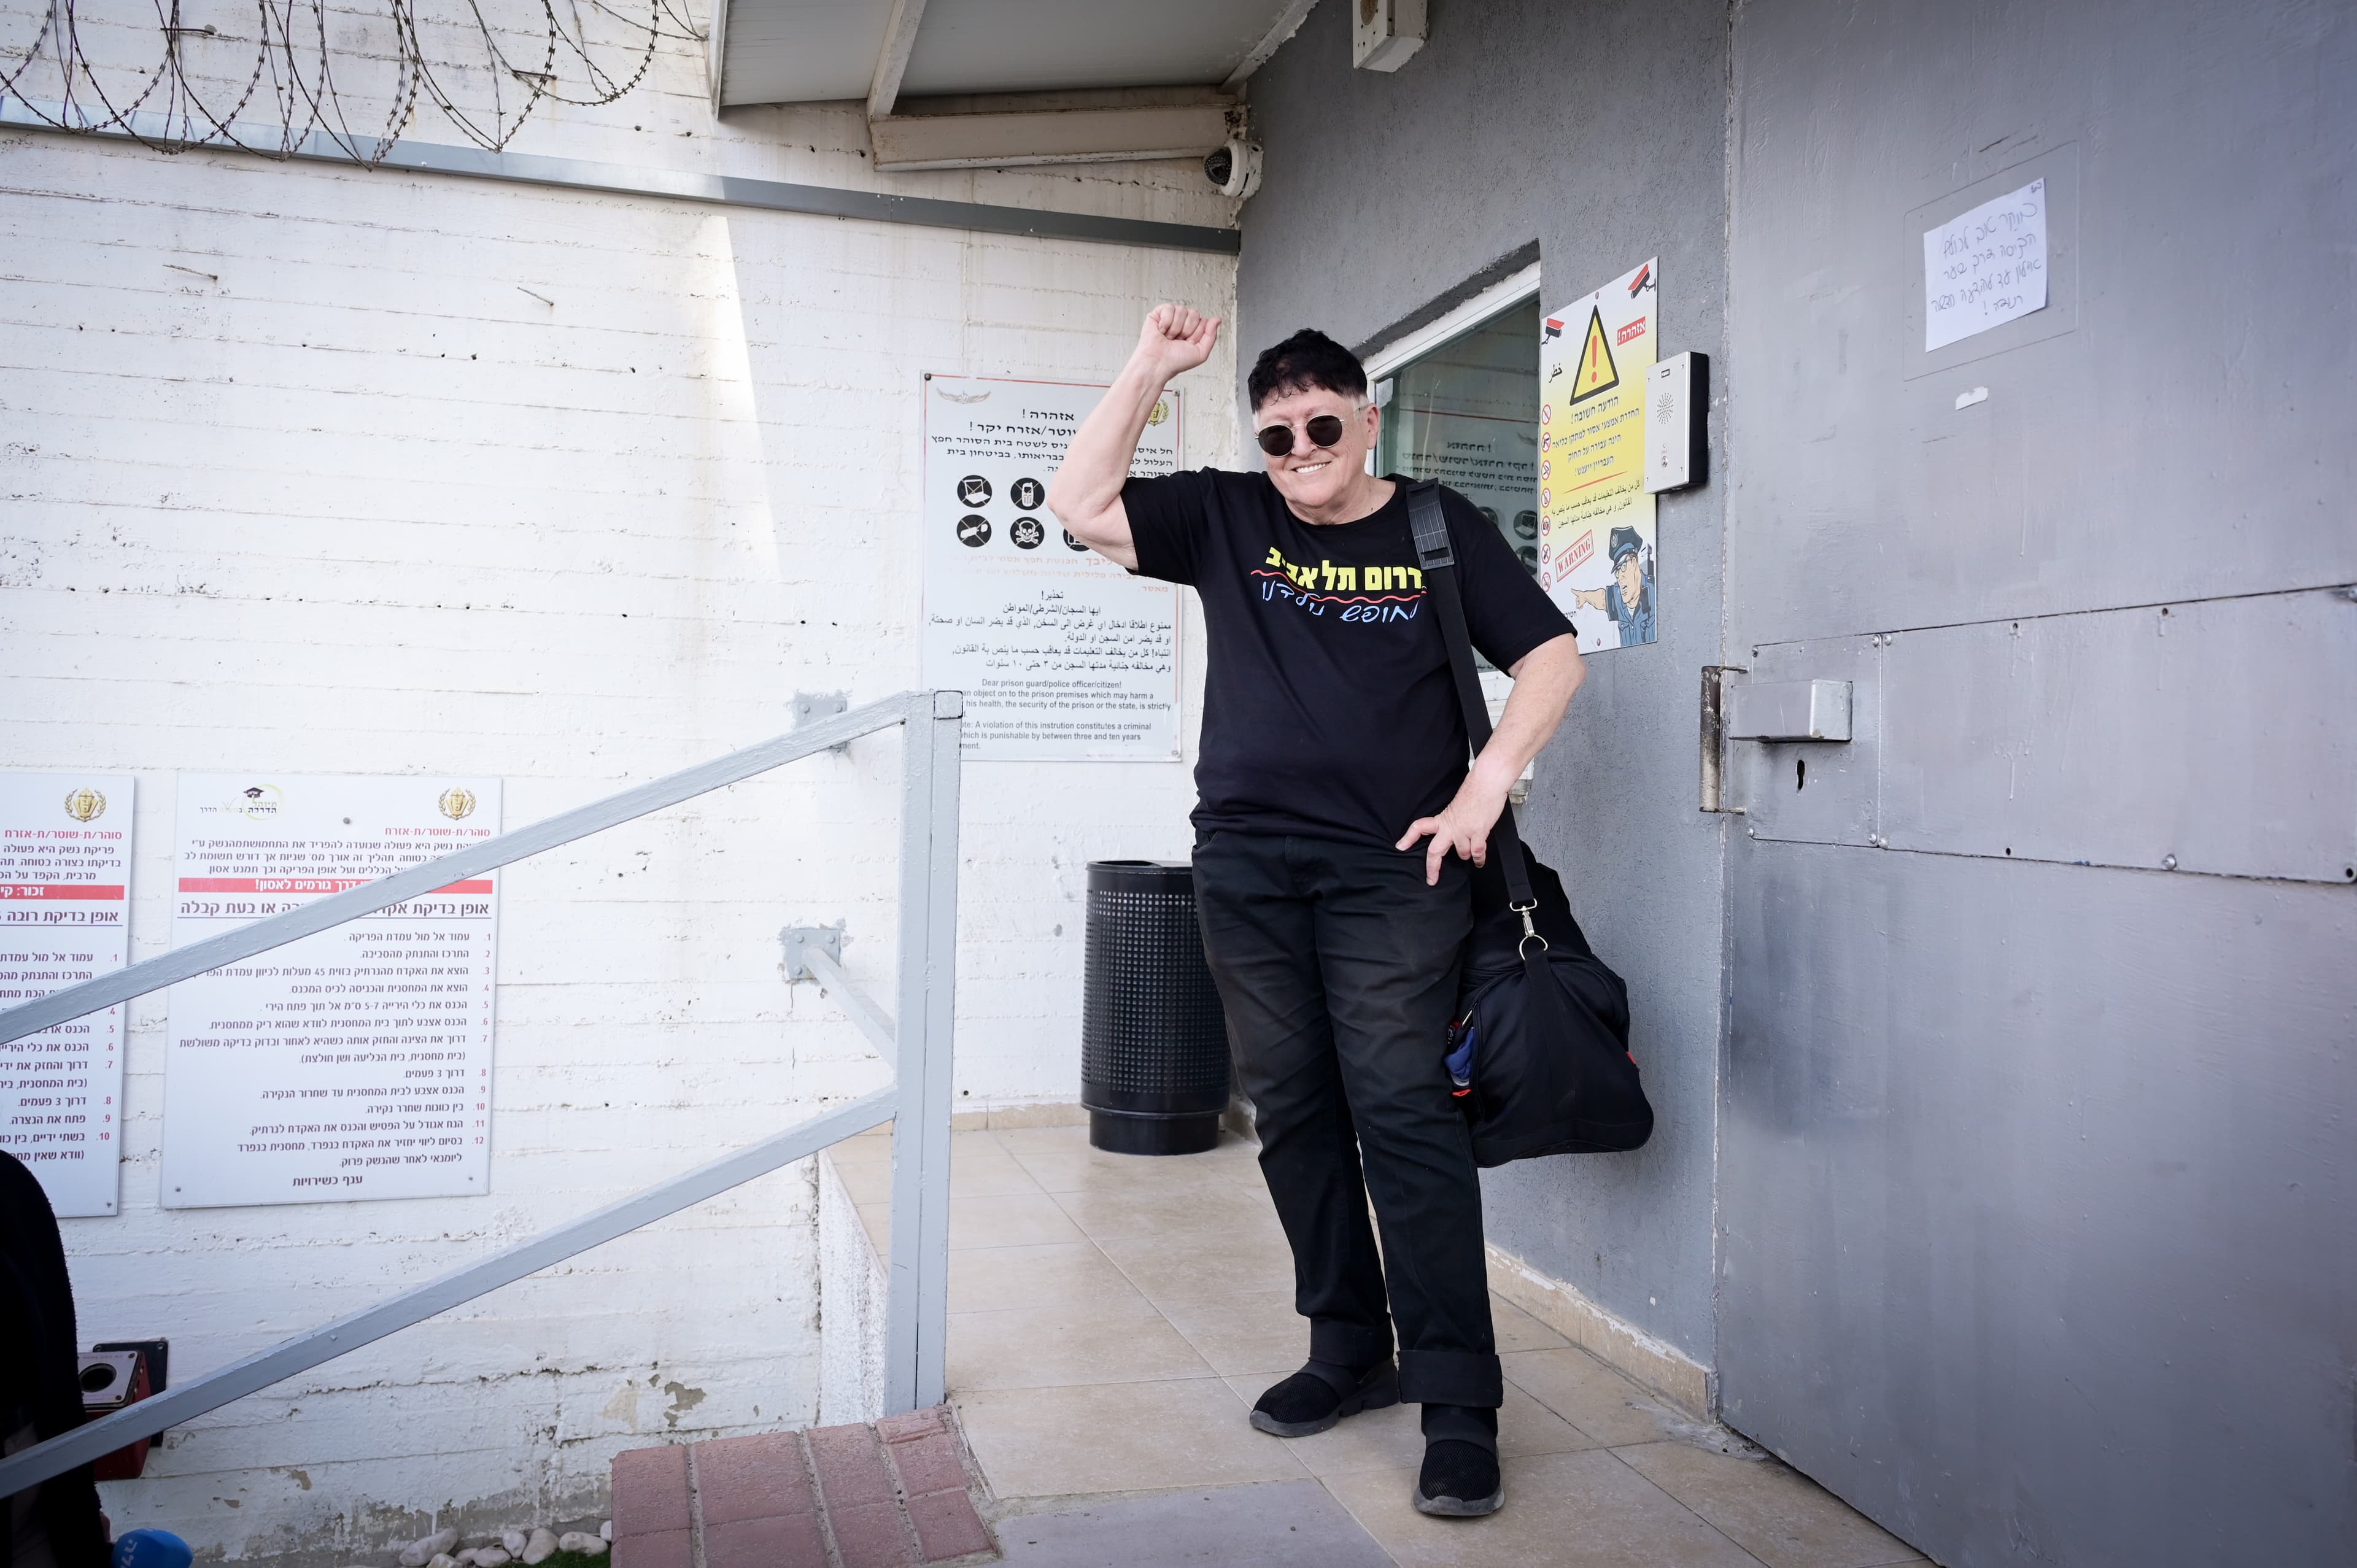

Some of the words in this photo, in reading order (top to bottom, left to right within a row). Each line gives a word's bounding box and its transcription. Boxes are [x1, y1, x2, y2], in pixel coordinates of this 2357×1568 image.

[1618, 321, 1646, 344] אזהרה!
[1549, 363, 1563, 383] خطر
[1598, 396, 1619, 412] הודעה
[1029, 411, 1074, 420] אזהרה
[1571, 406, 1596, 424] חשובה!
[1620, 407, 1639, 423] החדרת
[977, 423, 1001, 433] יקר
[1587, 423, 1600, 434] אסור
[1569, 428, 1585, 445] למתקן
[1608, 434, 1621, 446] הינה
[1552, 436, 1568, 449] כליאה
[1590, 439, 1607, 452] עבירה
[1583, 446, 1589, 455] על
[1568, 449, 1582, 463] החוק
[1593, 455, 1614, 471] העבריין
[1558, 538, 1590, 573] WARNING
[1266, 547, 1318, 589] אביב
[1322, 560, 1356, 590] תל
[1364, 566, 1422, 590] דרום
[1041, 589, 1063, 601] تحذير!
[1000, 679, 1023, 687] prison
[1026, 679, 1070, 689] guard/police
[973, 689, 995, 698] object
[1031, 690, 1054, 699] prison
[1056, 690, 1088, 700] premises
[1018, 700, 1047, 709] security
[1071, 701, 1094, 710] prison
[989, 732, 1029, 740] punishable
[1031, 732, 1040, 741] by
[4, 830, 122, 839] סוהר/ת-שוטר/ת-אזרח
[385, 827, 490, 836] סוהר/ת-שוטר/ת-אזרח
[4, 844, 34, 852] פעולה
[59, 846, 80, 855] נשק
[83, 846, 114, 855] פריקת
[255, 879, 292, 891] לאסון!
[295, 879, 331, 890] גורמים
[181, 900, 220, 916] קבלה
[225, 903, 255, 913] בעת
[261, 903, 276, 913] או
[7, 910, 38, 922] רובה
[43, 911, 85, 924] בדיקת
[90, 911, 118, 924] אופן
[349, 933, 382, 943] הפריקה
[414, 931, 430, 941] מול
[433, 931, 445, 941] אל
[405, 950, 438, 960] והתנתק
[446, 1069, 464, 1079] דרוך
[18, 1097, 52, 1106] פעמים.
[65, 1097, 86, 1107] דרוך
[365, 1105, 393, 1114] נקירה.
[452, 1103, 463, 1113] בין
[9, 1116, 43, 1124] הנצרה.
[46, 1115, 61, 1124] את
[64, 1114, 85, 1123] פתח
[292, 1176, 338, 1186] כשירויות
[343, 1175, 362, 1186] ענף
